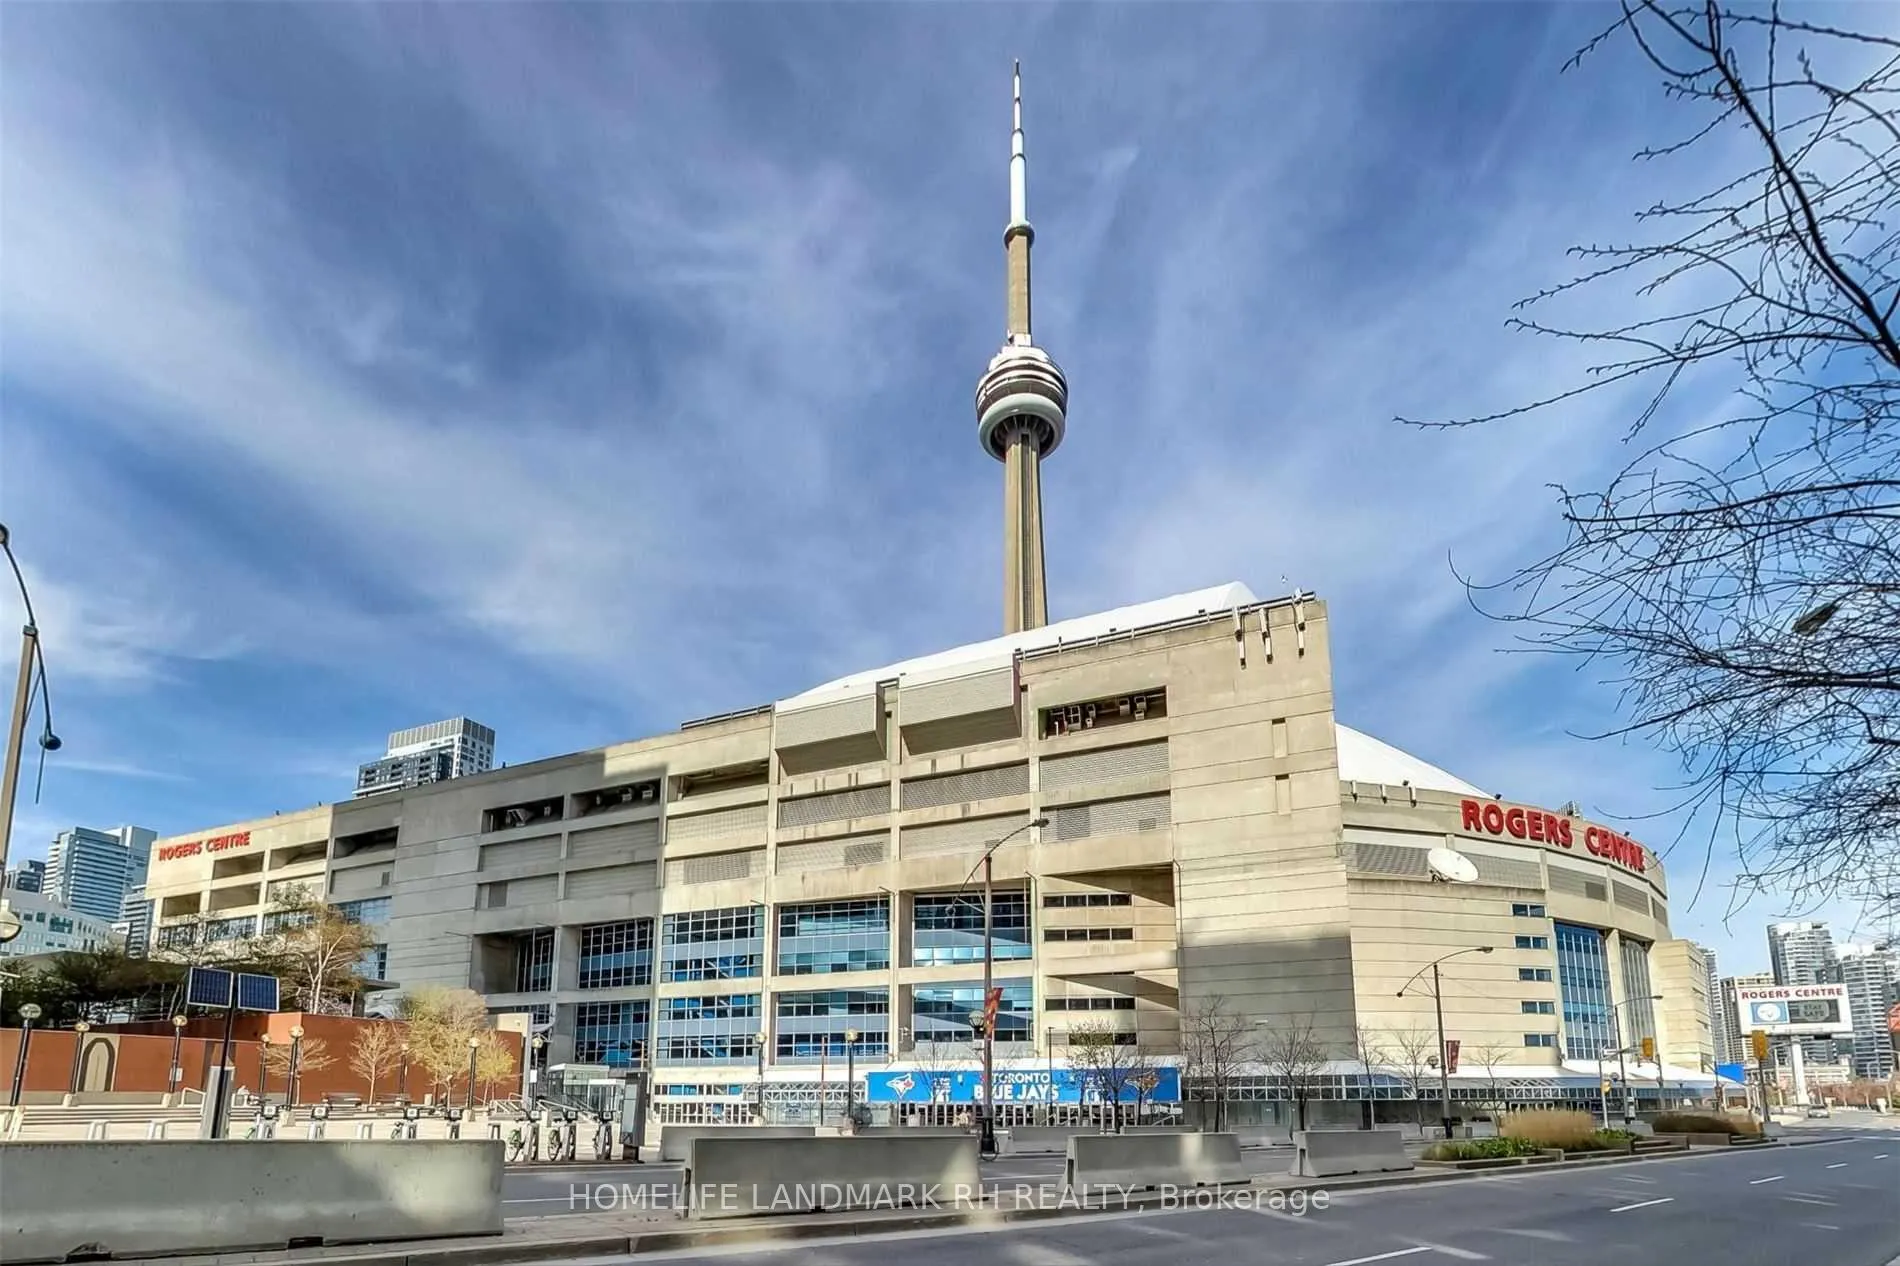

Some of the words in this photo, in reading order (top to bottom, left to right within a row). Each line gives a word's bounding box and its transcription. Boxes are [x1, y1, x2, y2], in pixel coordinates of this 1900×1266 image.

[1461, 799, 1573, 849] ROGERS
[1585, 827, 1646, 874] CENTRE
[158, 841, 203, 861] ROGERS
[206, 831, 251, 852] CENTRE
[1741, 989, 1791, 1000] ROGERS
[1795, 987, 1844, 998] CENTRE
[991, 1072, 1051, 1085] TORONTO
[973, 1083, 1014, 1101] BUE
[1016, 1083, 1061, 1101] JAYS
